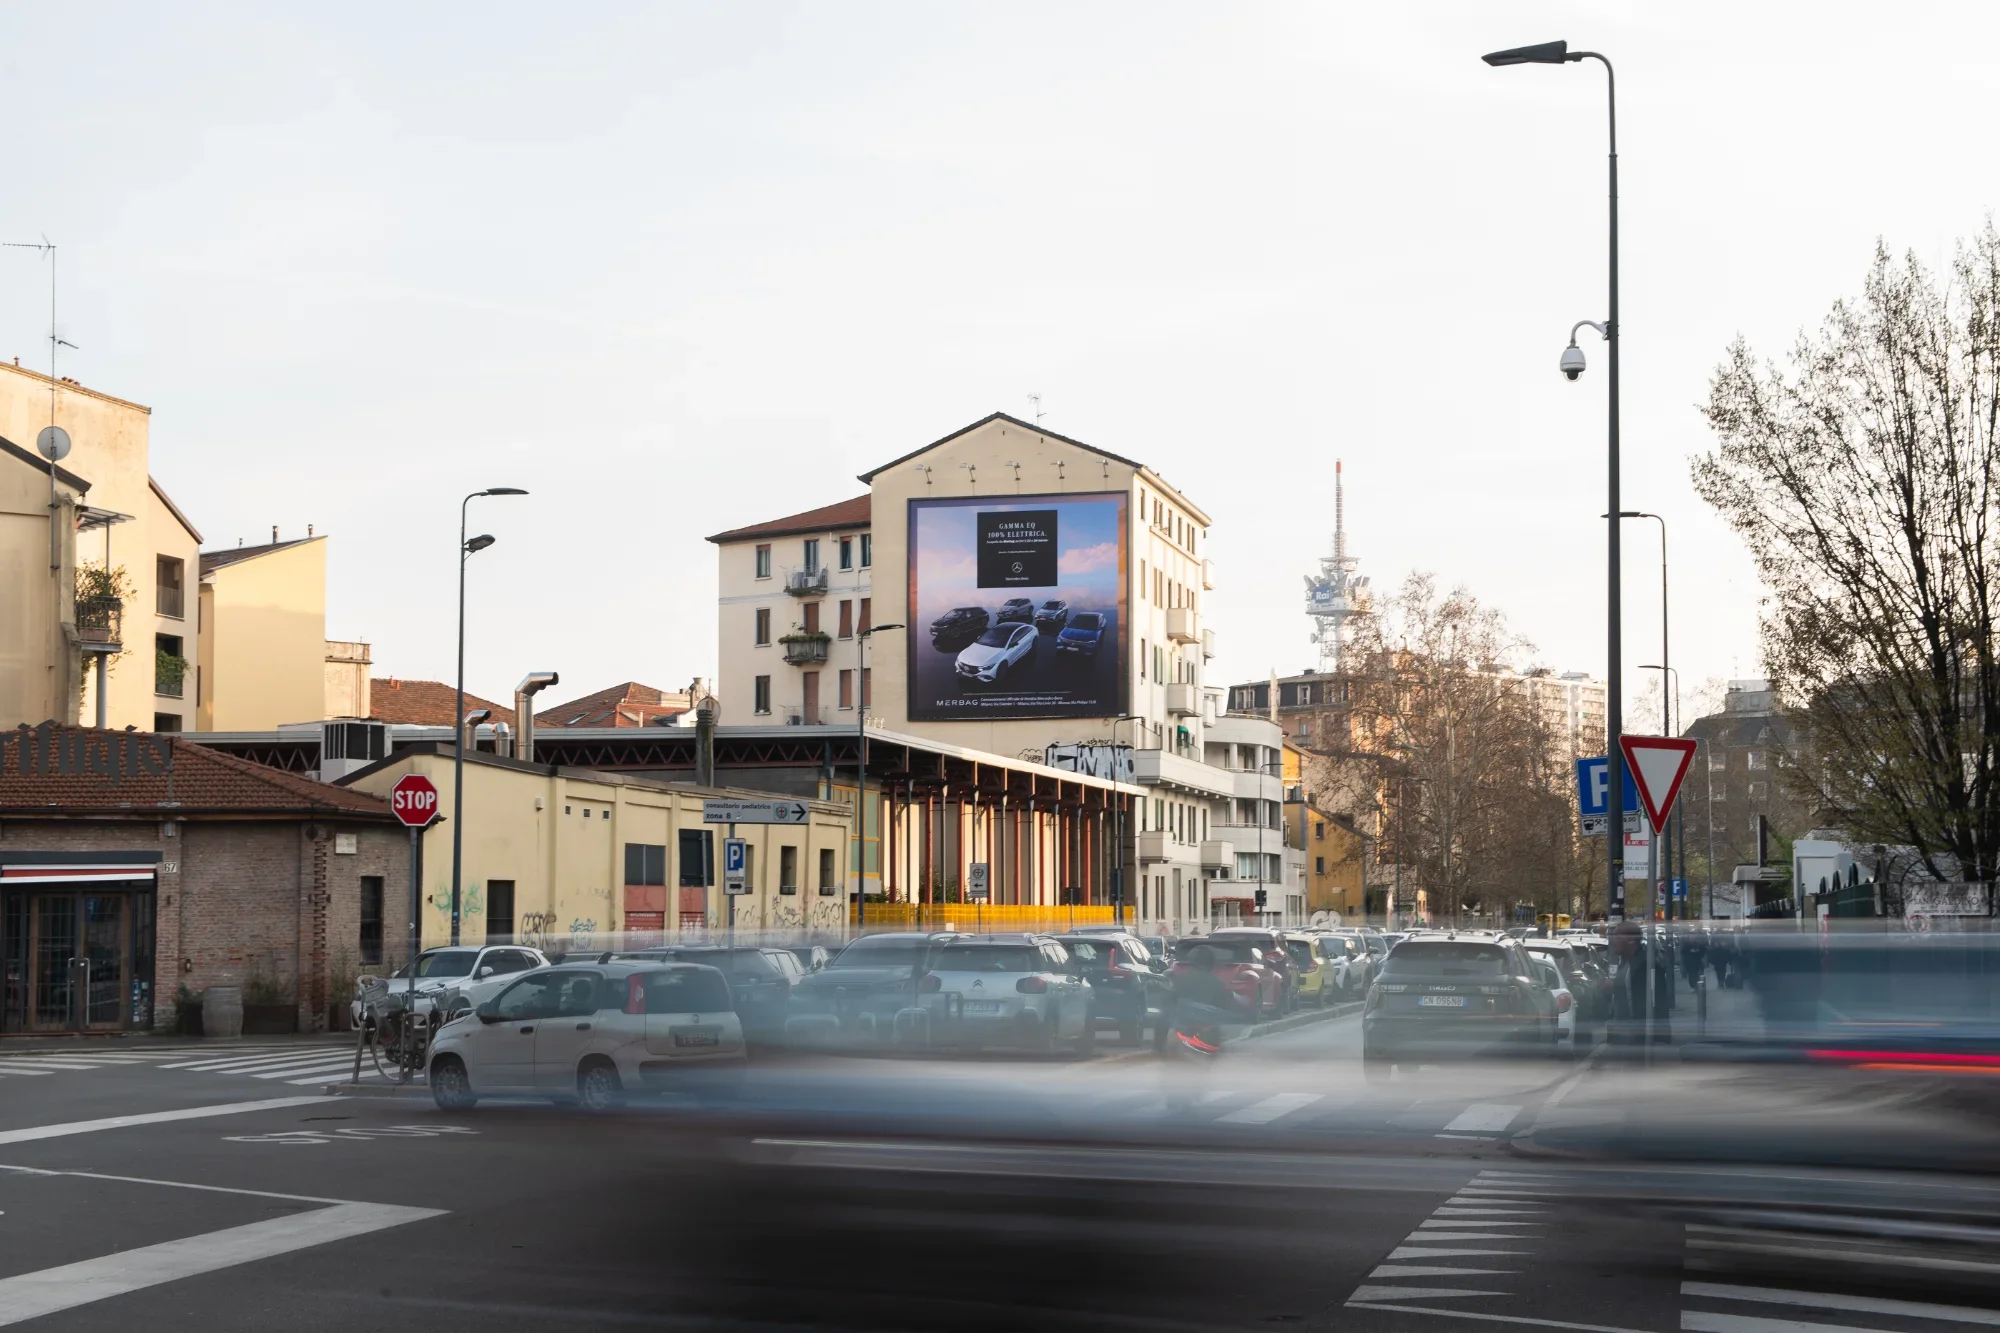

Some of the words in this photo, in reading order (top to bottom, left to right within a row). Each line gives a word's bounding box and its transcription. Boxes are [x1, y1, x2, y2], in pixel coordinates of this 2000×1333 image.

[1026, 522, 1036, 530] EQ
[1007, 530, 1047, 538] ELETTRICA.
[1316, 590, 1330, 600] Rai
[395, 790, 436, 810] STOP
[726, 812, 732, 820] 8
[729, 845, 741, 869] P
[164, 862, 176, 873] 67
